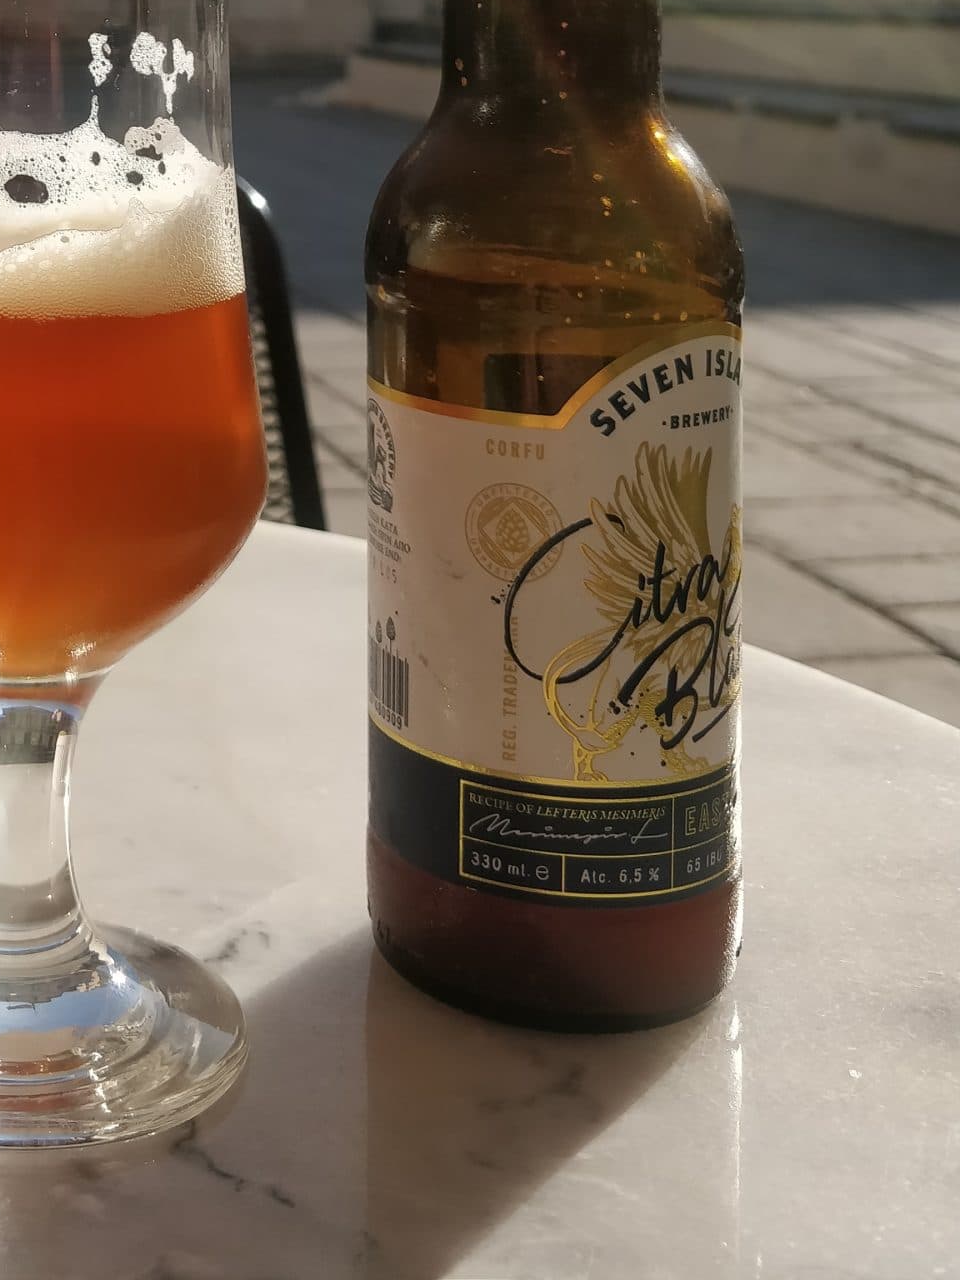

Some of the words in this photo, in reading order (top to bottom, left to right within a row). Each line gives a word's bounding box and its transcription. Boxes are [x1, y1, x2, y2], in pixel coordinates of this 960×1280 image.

[590, 354, 694, 436] SEVEN
[670, 405, 732, 429] BREWERY
[485, 438, 546, 461] CORFU
[504, 513, 732, 684] Citra
[502, 725, 517, 762] REG.
[469, 792, 513, 811] RECIPE
[515, 802, 534, 815] OF
[537, 806, 597, 823] LEFTERIS
[599, 806, 666, 821] MESIMERIS
[471, 851, 502, 871] 330
[507, 863, 531, 877] ml.
[580, 869, 612, 884] Alc.
[687, 857, 701, 873] 65
